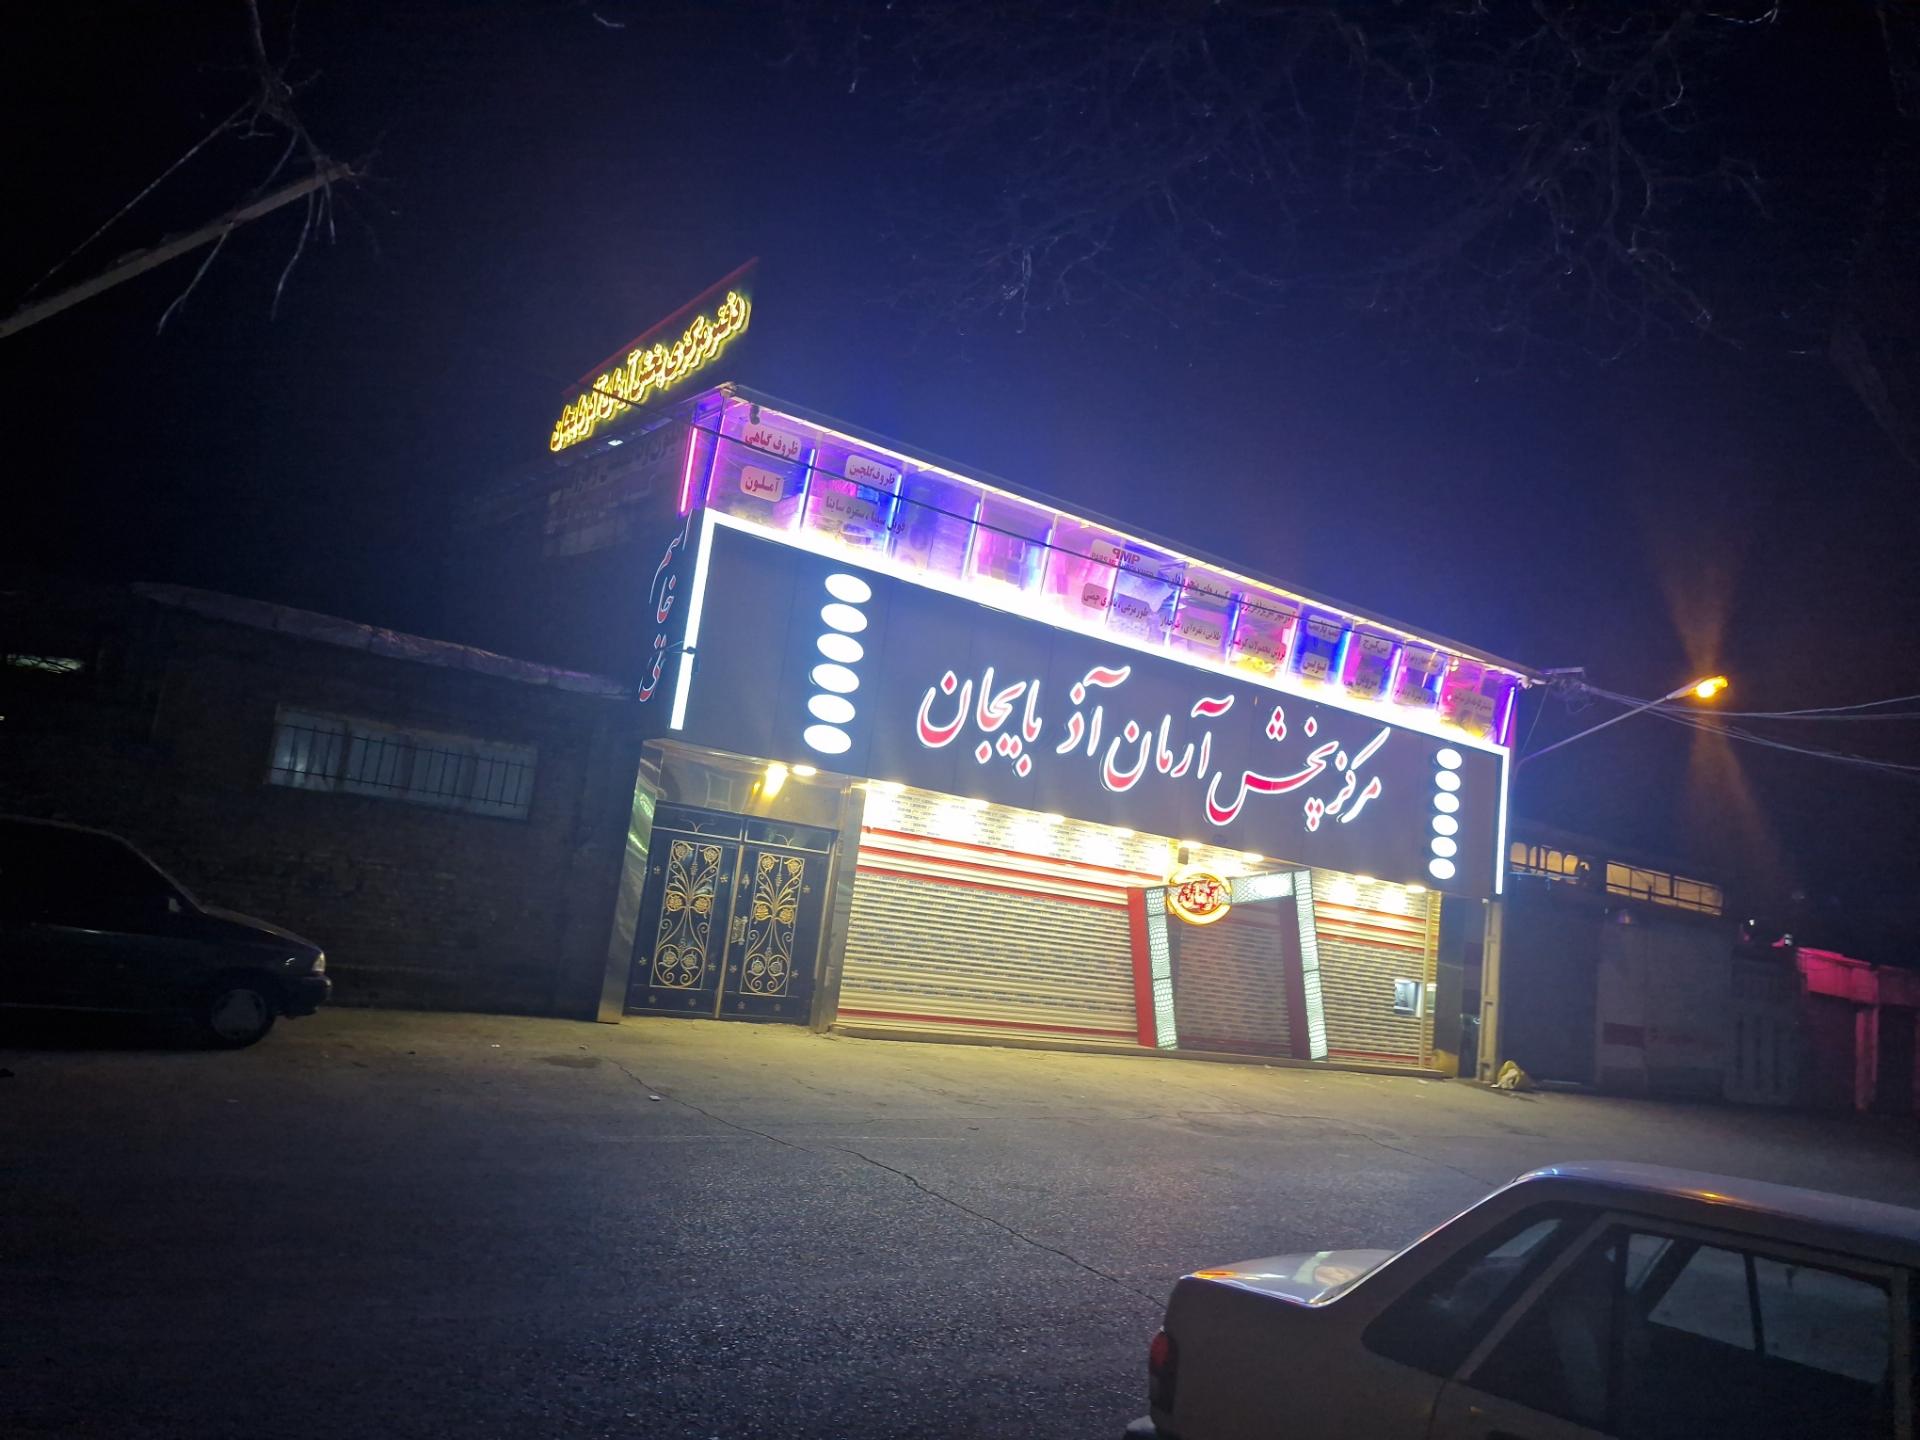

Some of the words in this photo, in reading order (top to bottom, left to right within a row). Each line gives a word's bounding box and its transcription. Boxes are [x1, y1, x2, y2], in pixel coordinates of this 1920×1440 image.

[773, 434, 799, 459] ظروف
[869, 467, 895, 487] ظروف
[1103, 694, 1235, 792] آرمان
[1204, 706, 1341, 832] پخش
[1321, 726, 1392, 823] مرکز
